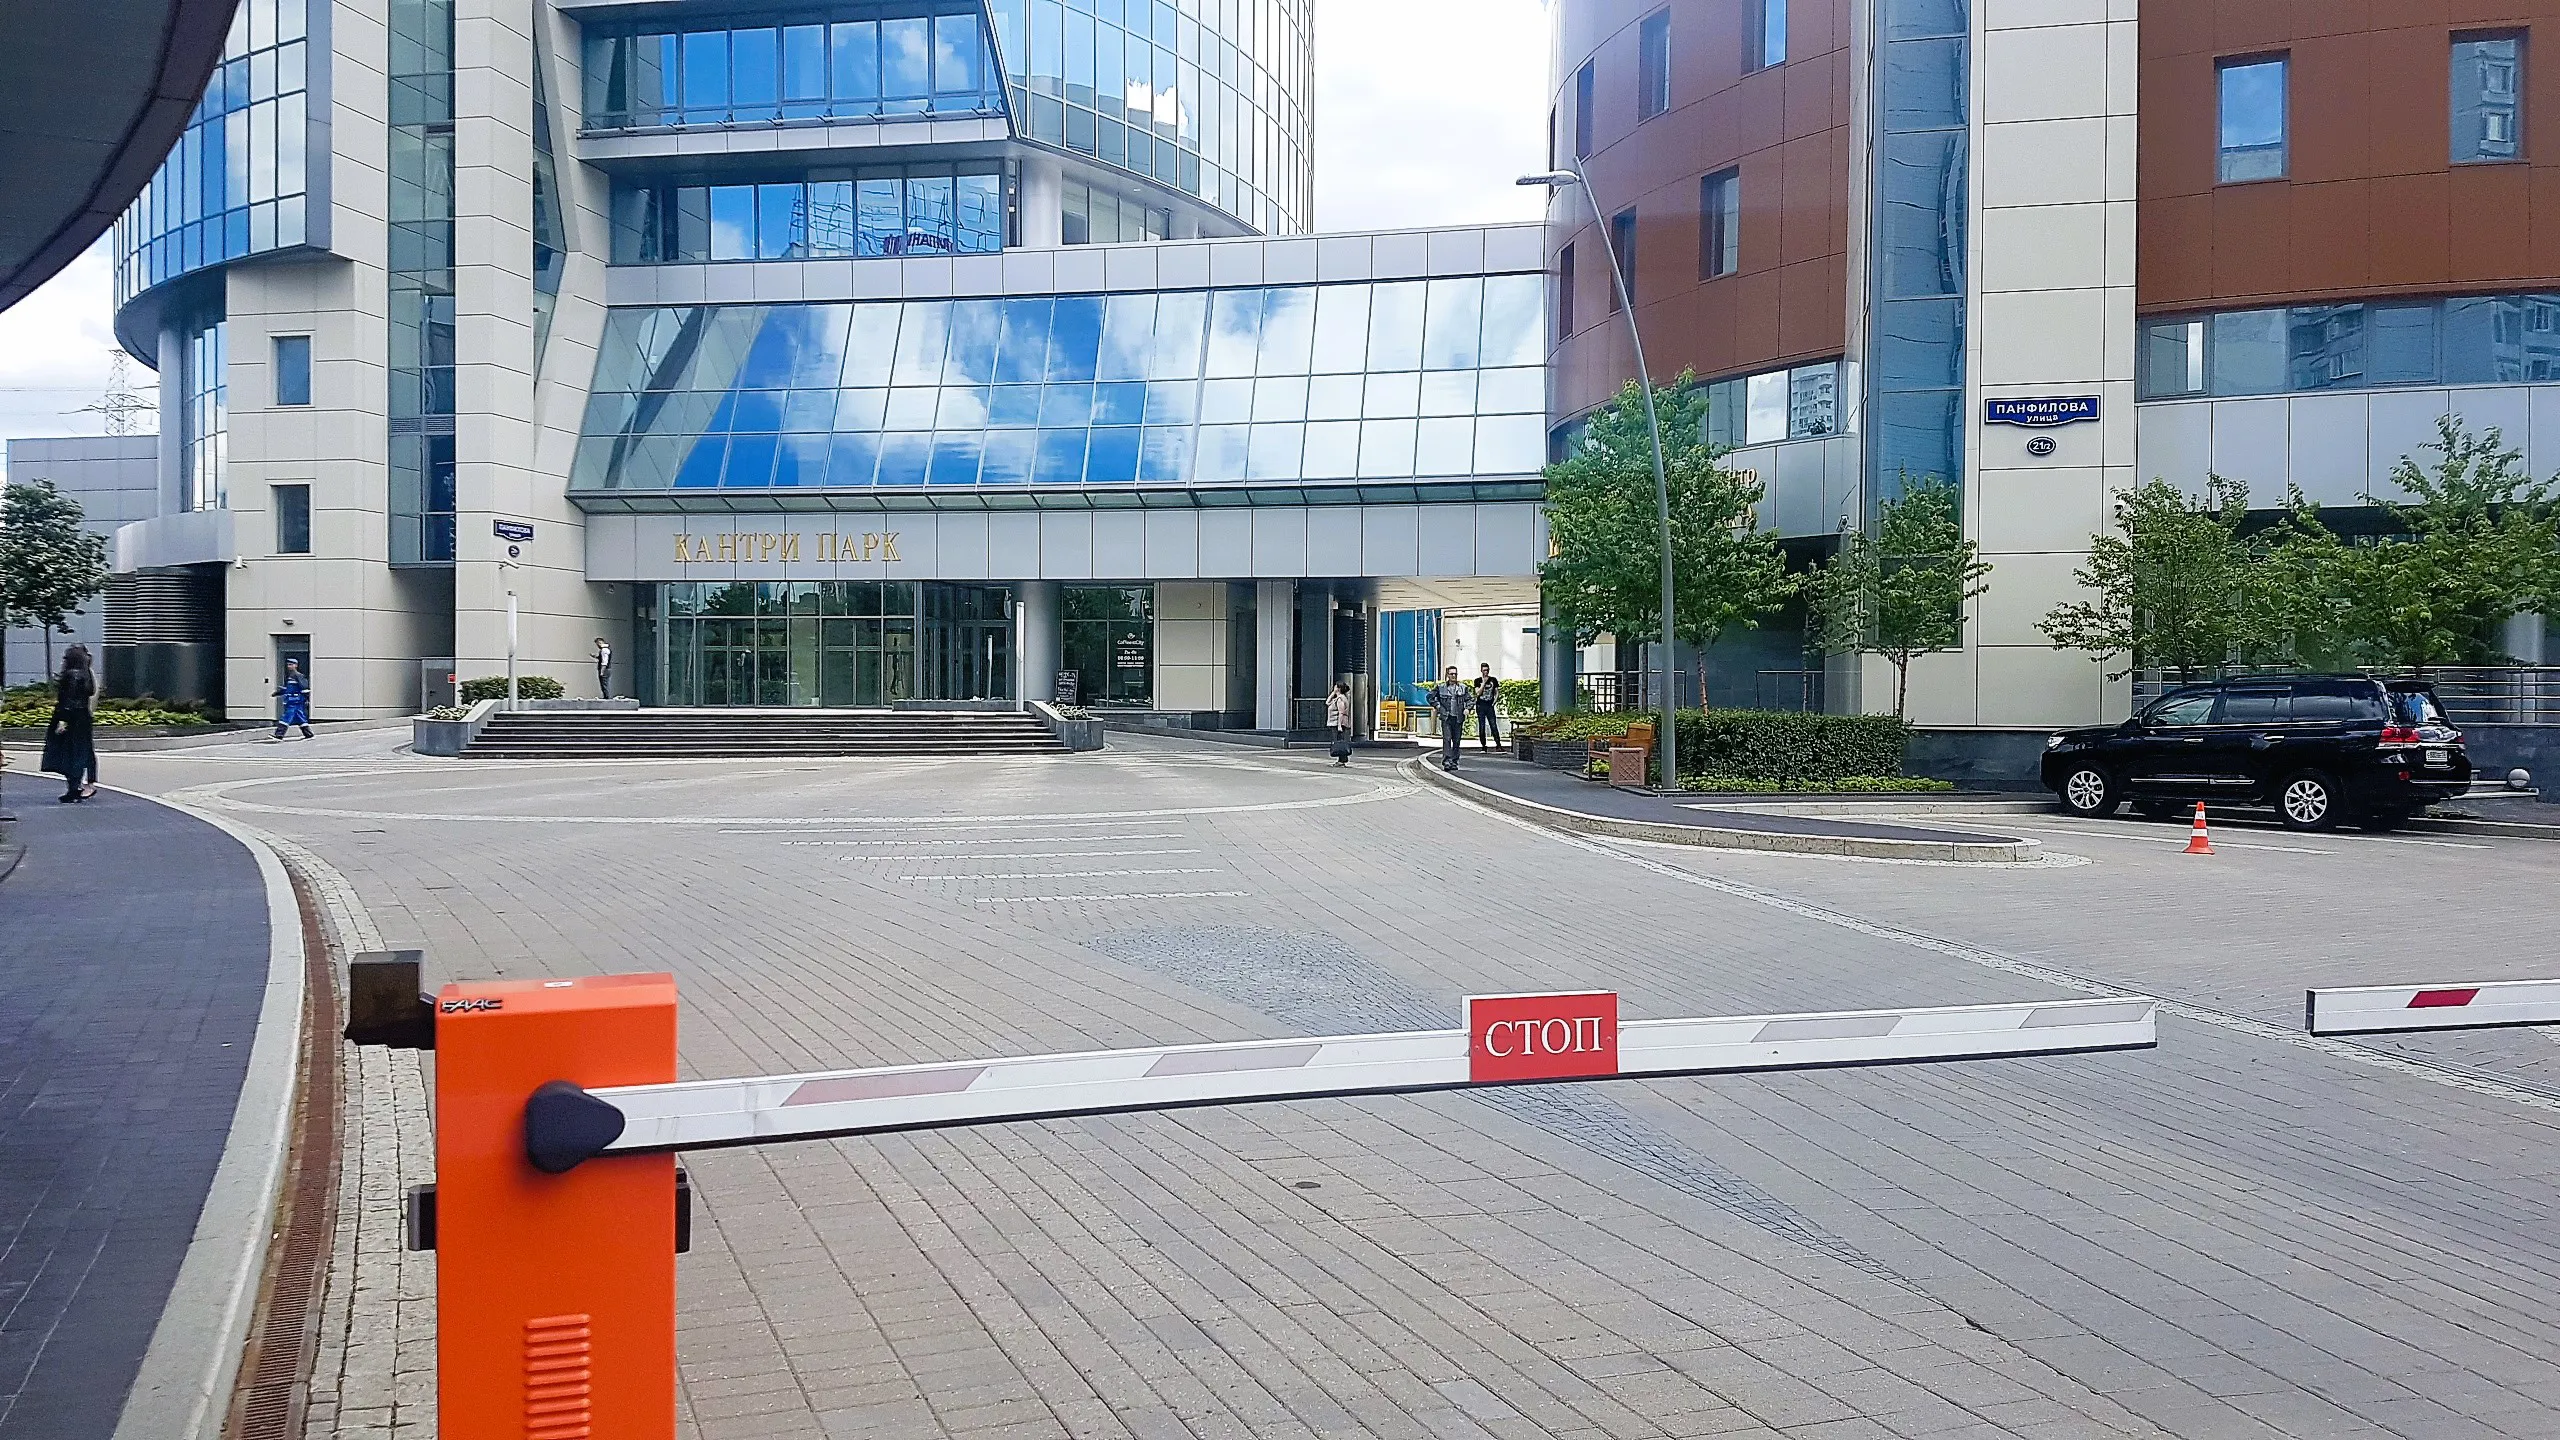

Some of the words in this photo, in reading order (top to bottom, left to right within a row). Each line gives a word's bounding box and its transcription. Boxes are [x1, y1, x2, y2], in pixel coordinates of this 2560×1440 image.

[1996, 402, 2089, 414] ПАНФИЛОВА
[2026, 414, 2059, 423] улица
[673, 533, 800, 562] КАНТРИ
[816, 533, 901, 562] ПАРК
[441, 999, 503, 1013] FAAC
[1485, 1016, 1604, 1058] СТОП
